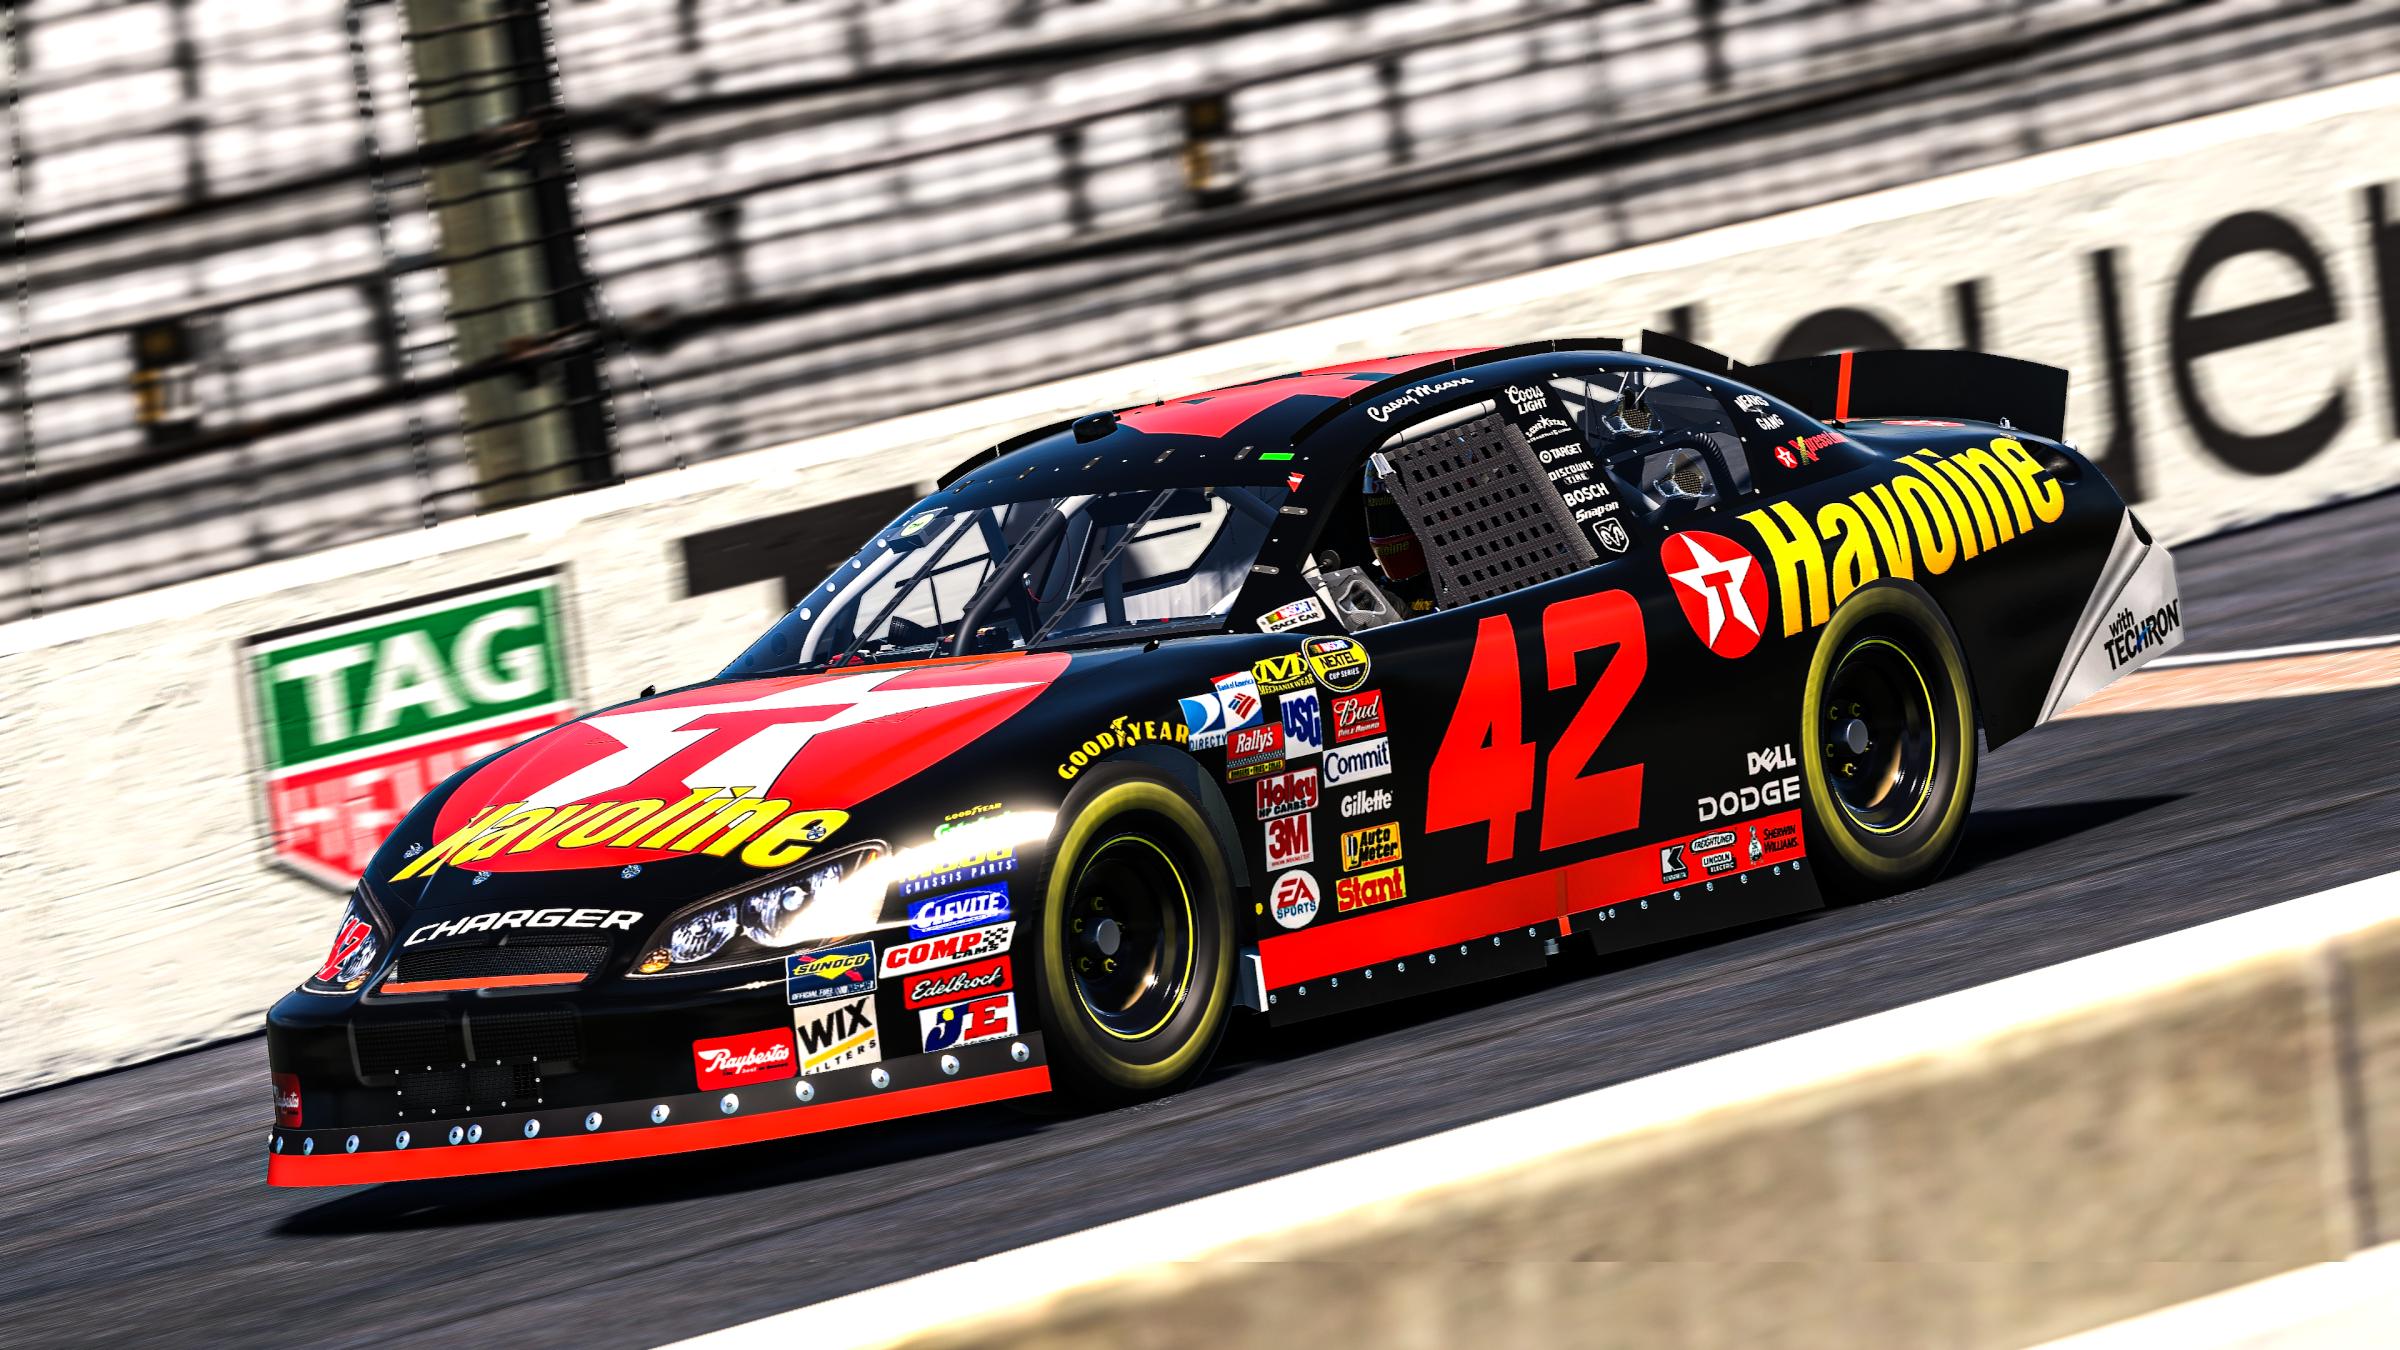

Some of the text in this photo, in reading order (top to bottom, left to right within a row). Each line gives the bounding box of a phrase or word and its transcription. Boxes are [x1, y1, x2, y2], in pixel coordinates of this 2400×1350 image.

[1367, 395, 1420, 422] Casey
[1505, 385, 1544, 404] Coors
[1518, 398, 1548, 415] LIGHT
[1756, 413, 1784, 430] GANG
[1551, 443, 1582, 459] TARGET
[1548, 460, 1594, 481] DISCOUNT
[1563, 482, 1610, 507] BOSCH
[1736, 437, 2065, 639] Havoline
[1270, 612, 1319, 632] RACE CAR
[2104, 598, 2180, 671] TECHRON
[2109, 607, 2135, 638] with
[1319, 651, 1360, 669] NEXTEL
[1329, 667, 1360, 680] CUP SERIES
[274, 605, 541, 747] TAG
[1235, 678, 1254, 688] America
[1294, 673, 1315, 687] WEAR
[1281, 694, 1321, 748] USG
[1334, 695, 1379, 727] Bud
[1235, 727, 1274, 753] Rally's
[1425, 588, 1648, 865] 42
[1058, 716, 1189, 780] GOODYEAR
[1325, 742, 1389, 783] Commit
[1747, 743, 1796, 775] DELL
[1258, 774, 1317, 809] Holley
[1341, 789, 1392, 818] Gillette
[1698, 775, 1800, 822] DODGE
[944, 802, 1003, 821] GOODYEAR
[1274, 800, 1307, 815] CARBS
[388, 785, 851, 884] Havoline
[1269, 814, 1309, 860] 3M
[1360, 828, 1391, 847] Auto
[1694, 834, 1734, 849] FREIGHTLINER
[1763, 824, 1796, 840] SHERWIN
[1360, 842, 1398, 862] Meter
[1703, 852, 1731, 866] LINCOLN
[906, 871, 962, 895] CHASSIS
[971, 860, 1012, 879] PARTS
[1338, 868, 1404, 912] Stant
[1277, 877, 1315, 909] EA
[914, 891, 1001, 928] CLEVITE
[1277, 901, 1316, 919] SPORTS
[403, 908, 644, 948] CHARGER
[797, 955, 866, 974] SUNOCO
[886, 931, 982, 969] COMP
[952, 943, 1000, 960] CAMS
[911, 967, 1002, 1000] Edelbrock
[797, 996, 872, 1055] WIX
[698, 1044, 790, 1075] Raybestos
[805, 1039, 877, 1076] FILTERS
